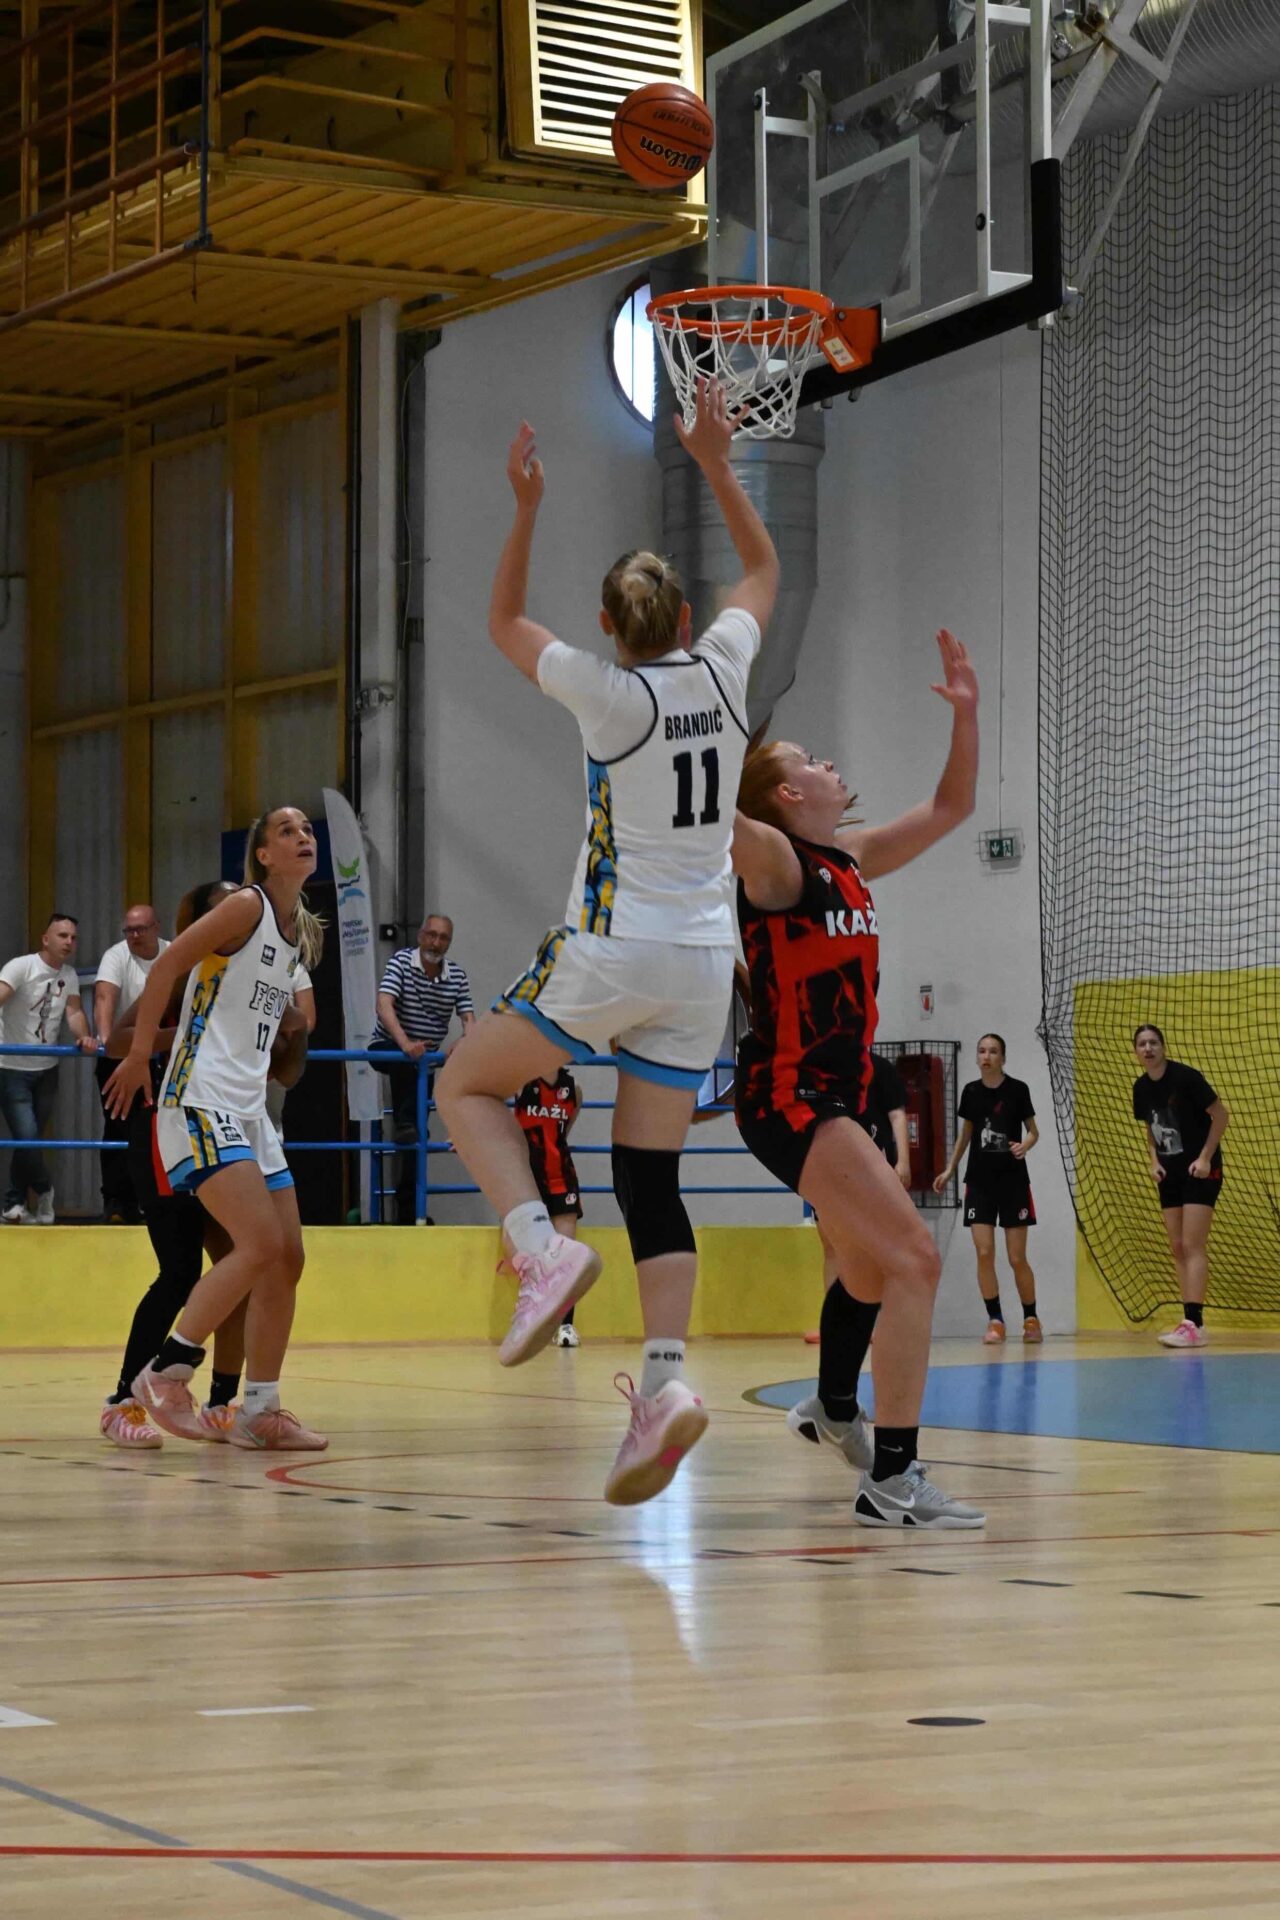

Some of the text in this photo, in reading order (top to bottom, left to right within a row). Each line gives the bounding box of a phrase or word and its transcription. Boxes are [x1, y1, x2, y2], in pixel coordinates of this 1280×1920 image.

[640, 134, 703, 172] Wilson
[672, 747, 721, 829] 11
[249, 980, 289, 1020] FSV
[255, 1022, 271, 1052] 17
